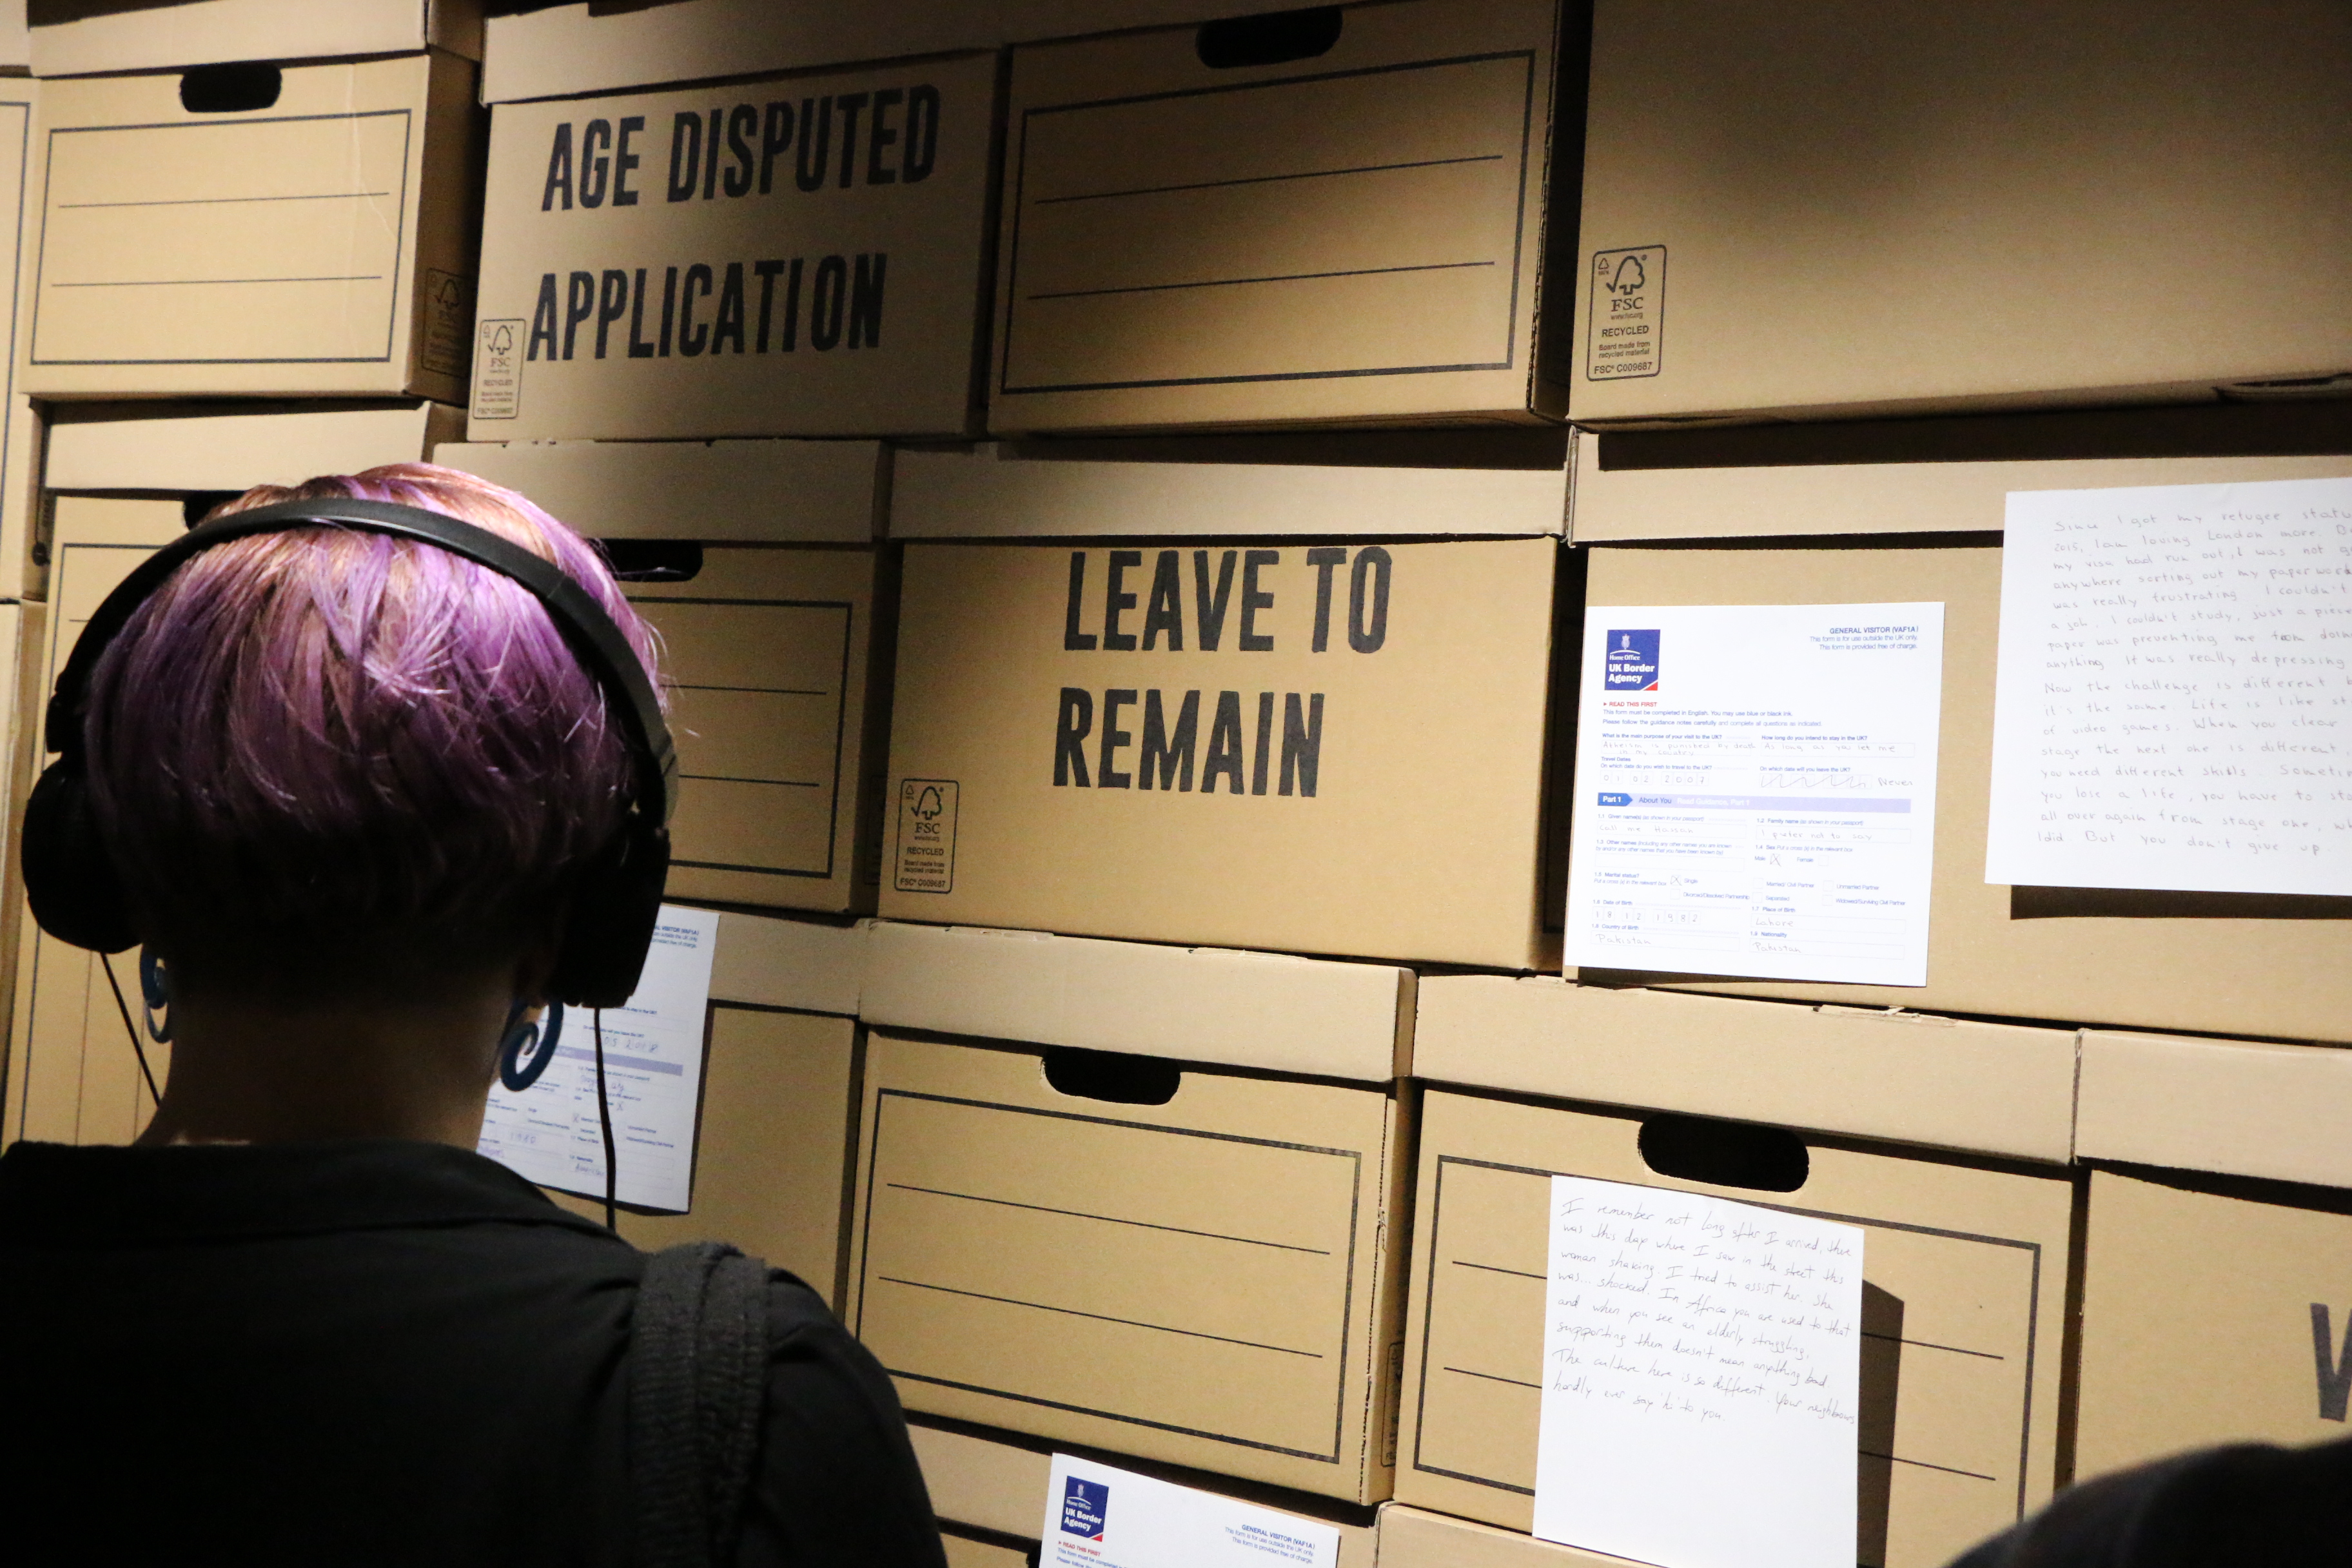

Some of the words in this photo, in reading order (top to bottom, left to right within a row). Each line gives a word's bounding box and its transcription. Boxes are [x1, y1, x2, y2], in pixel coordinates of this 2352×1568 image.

[542, 116, 645, 211] AGE
[668, 84, 940, 202] DISPUTED
[527, 253, 888, 361] APPLICATION
[1611, 297, 1643, 311] FSC
[1602, 326, 1649, 337] RECYCLED
[1064, 550, 1279, 651] LEAVE
[1306, 546, 1392, 653] TO
[1609, 674, 1642, 683] Agency
[1054, 687, 1325, 797] REMAIN
[1877, 778, 1913, 786] Never
[915, 822, 940, 834] FSC
[906, 847, 944, 856] RECYCLED
[1756, 917, 1794, 927] Lahore
[1595, 934, 1651, 945] Pakistan
[1752, 942, 1801, 953] Pakistan
[1561, 1198, 1583, 1216] I
[1598, 1202, 1655, 1219] remember
[1665, 1213, 1692, 1226] not
[1732, 1222, 1760, 1242] after
[1765, 1232, 1779, 1244] I
[1563, 1224, 1582, 1233] was
[1591, 1223, 1615, 1240] this
[1625, 1228, 1648, 1251] day
[1693, 1245, 1709, 1257] I
[1716, 1252, 1735, 1260] saw
[1761, 1254, 1776, 1271] the
[1784, 1262, 1815, 1279] street
[1823, 1268, 1844, 1284] this
[1562, 1251, 1596, 1262] woman
[1665, 1266, 1683, 1279] I
[1689, 1267, 1718, 1284] tried
[1725, 1275, 1737, 1288] to
[1745, 1282, 1781, 1295] assist
[1065, 1507, 1075, 1516] UK
[1077, 1510, 1102, 1524] Border
[1064, 1516, 1091, 1531] Agency
[1242, 1524, 1268, 1536] GENERAL
[1270, 1533, 1291, 1543] VISITOR
